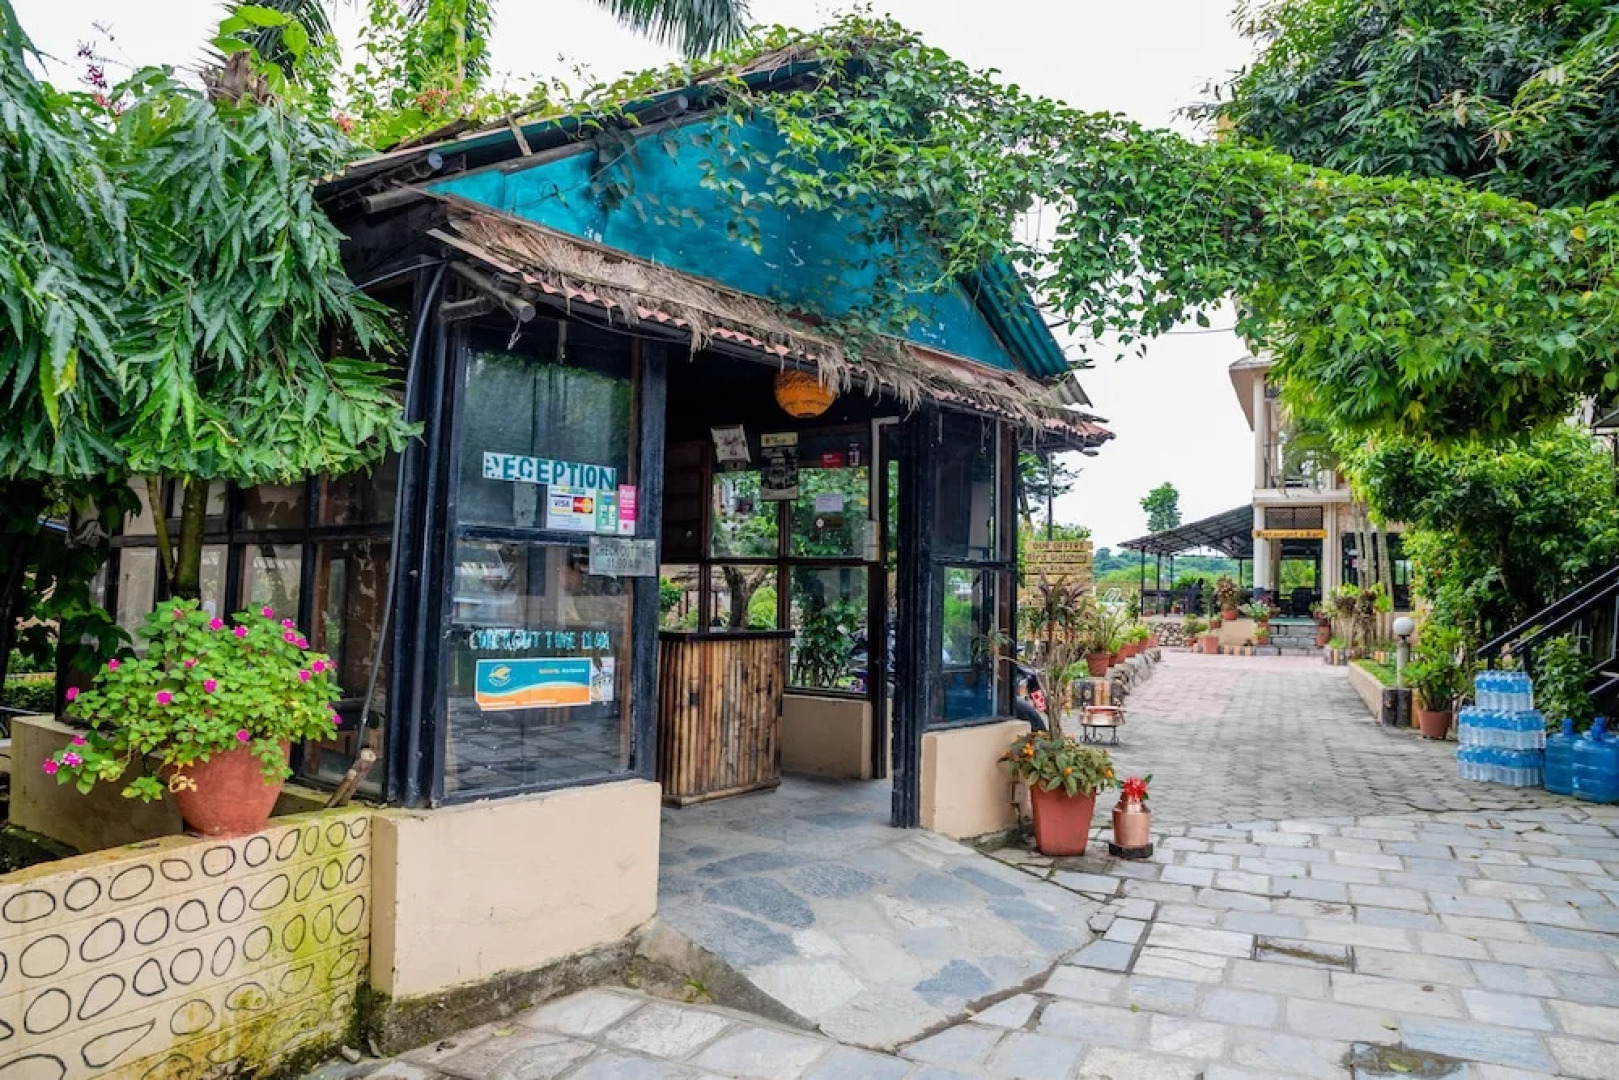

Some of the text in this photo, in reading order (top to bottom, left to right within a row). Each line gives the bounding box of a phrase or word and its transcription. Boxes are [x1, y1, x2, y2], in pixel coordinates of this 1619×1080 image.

[553, 499, 570, 508] VISA
[1027, 553, 1087, 563] Bird Watching
